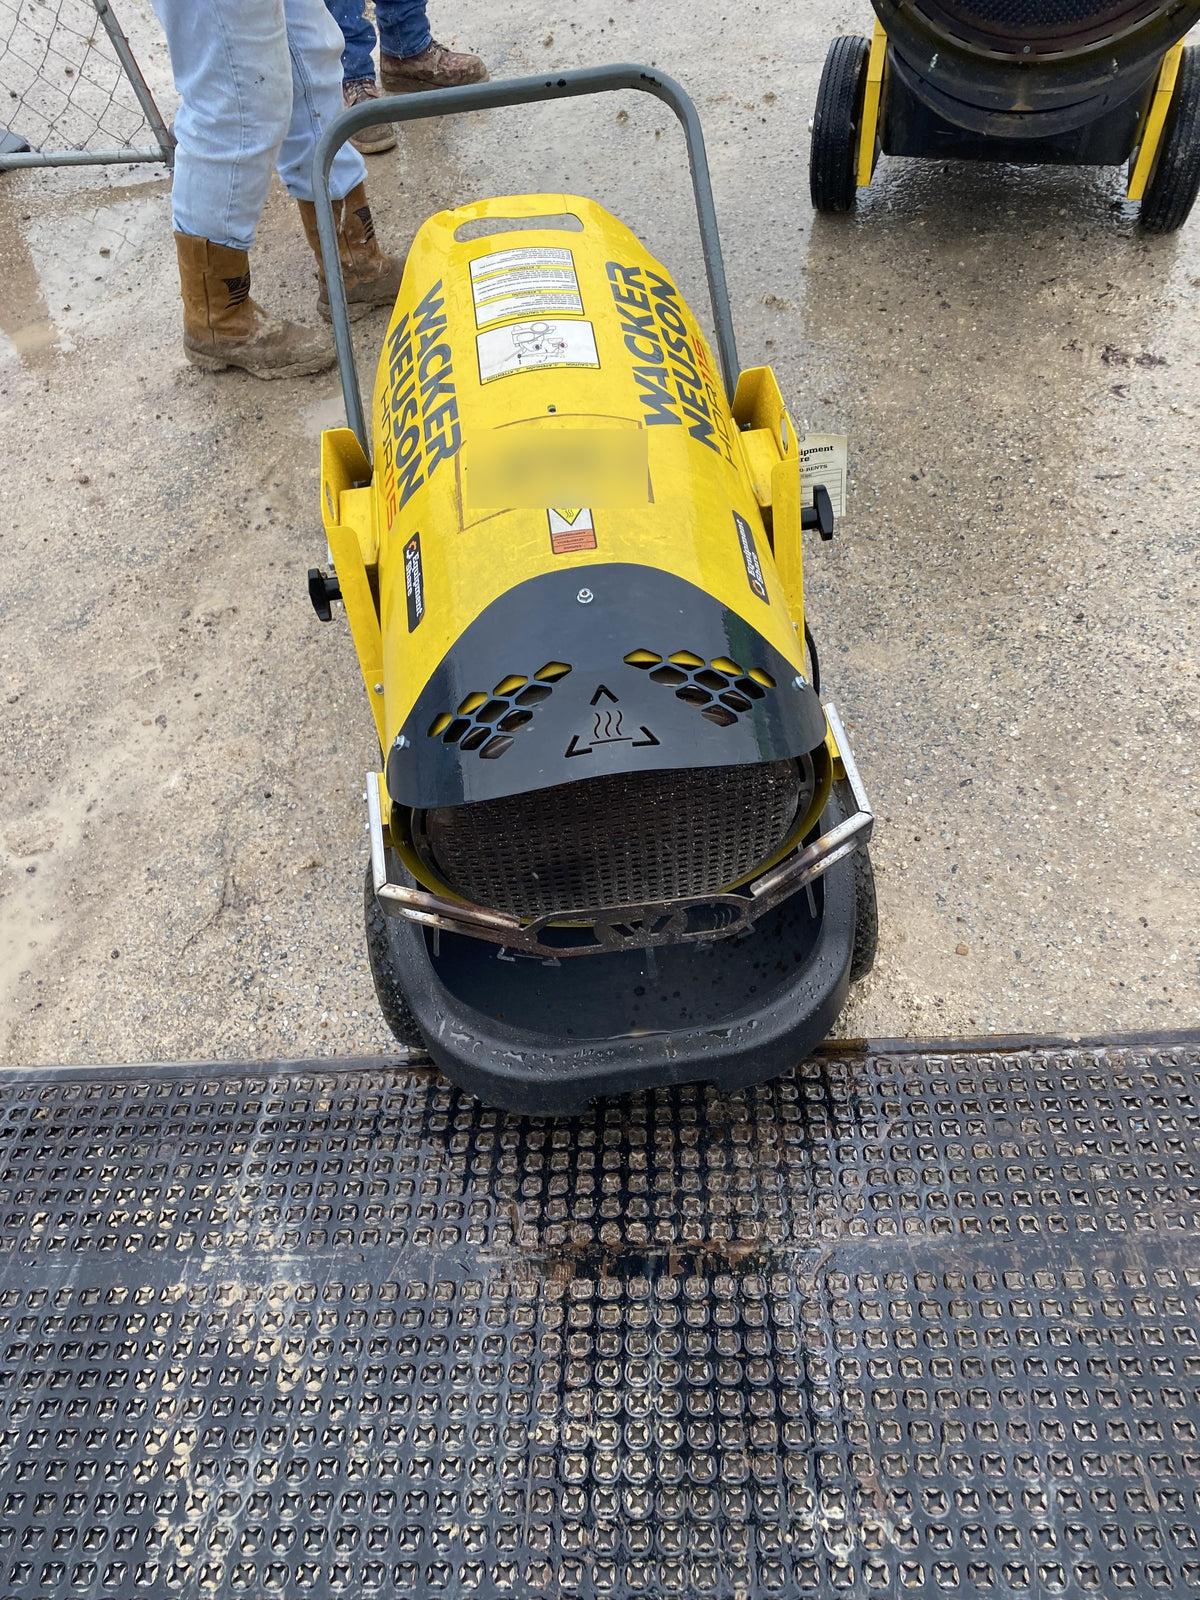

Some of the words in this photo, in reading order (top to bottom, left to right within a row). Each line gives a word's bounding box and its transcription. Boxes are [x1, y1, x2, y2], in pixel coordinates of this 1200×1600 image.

[388, 312, 425, 512] NEUSON
[413, 279, 463, 478] WACKER
[605, 261, 682, 425] WACKER
[645, 270, 722, 456] NEUSON
[800, 445, 834, 456] ipment
[412, 551, 423, 618] Equipment
[736, 518, 756, 578] Equipment
